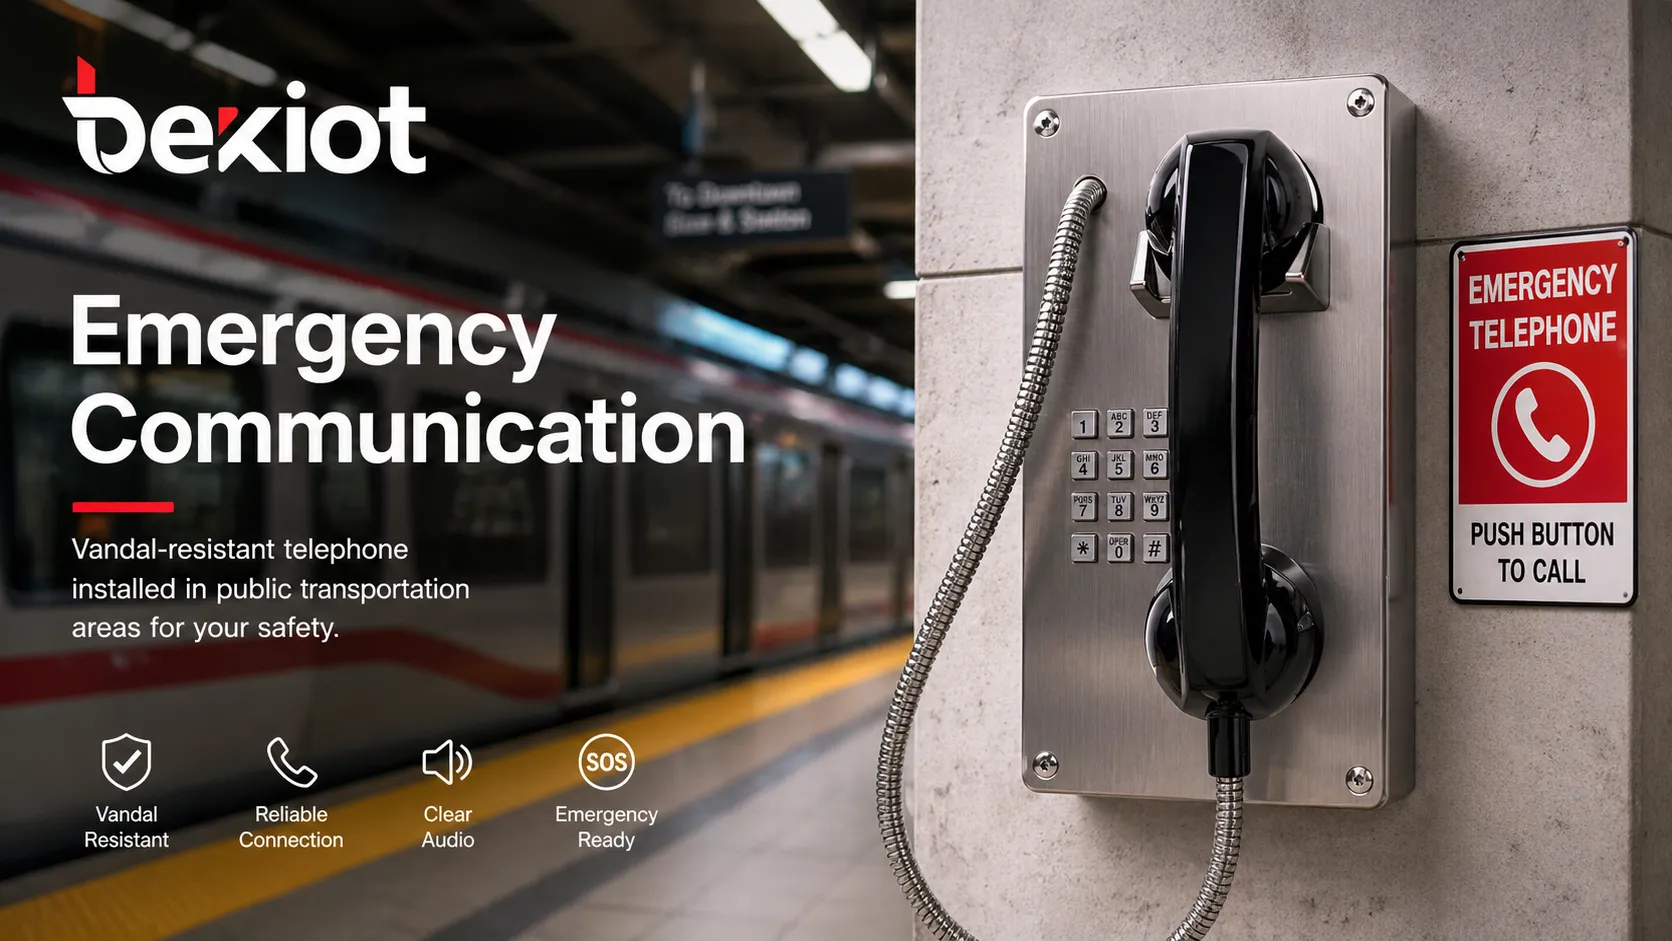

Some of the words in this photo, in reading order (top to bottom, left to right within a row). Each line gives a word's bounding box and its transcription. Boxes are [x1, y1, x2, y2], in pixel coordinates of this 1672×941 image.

[1469, 263, 1618, 305] EMERGENCY
[1469, 310, 1617, 350] TELEPHONE
[1080, 420, 1087, 434] 1
[1115, 421, 1124, 433] 2
[1151, 420, 1160, 433] 3
[1111, 454, 1127, 462] JKL
[1079, 463, 1088, 475] 4
[1115, 462, 1124, 475] 5
[1151, 462, 1160, 475] 6
[1079, 504, 1088, 517] 7
[1115, 504, 1124, 517] 8
[1151, 504, 1160, 517] 9
[1471, 521, 1525, 546] PUSH
[1532, 521, 1615, 546] BUTTON
[1498, 558, 1526, 583] TO
[1532, 558, 1587, 584] CALL
